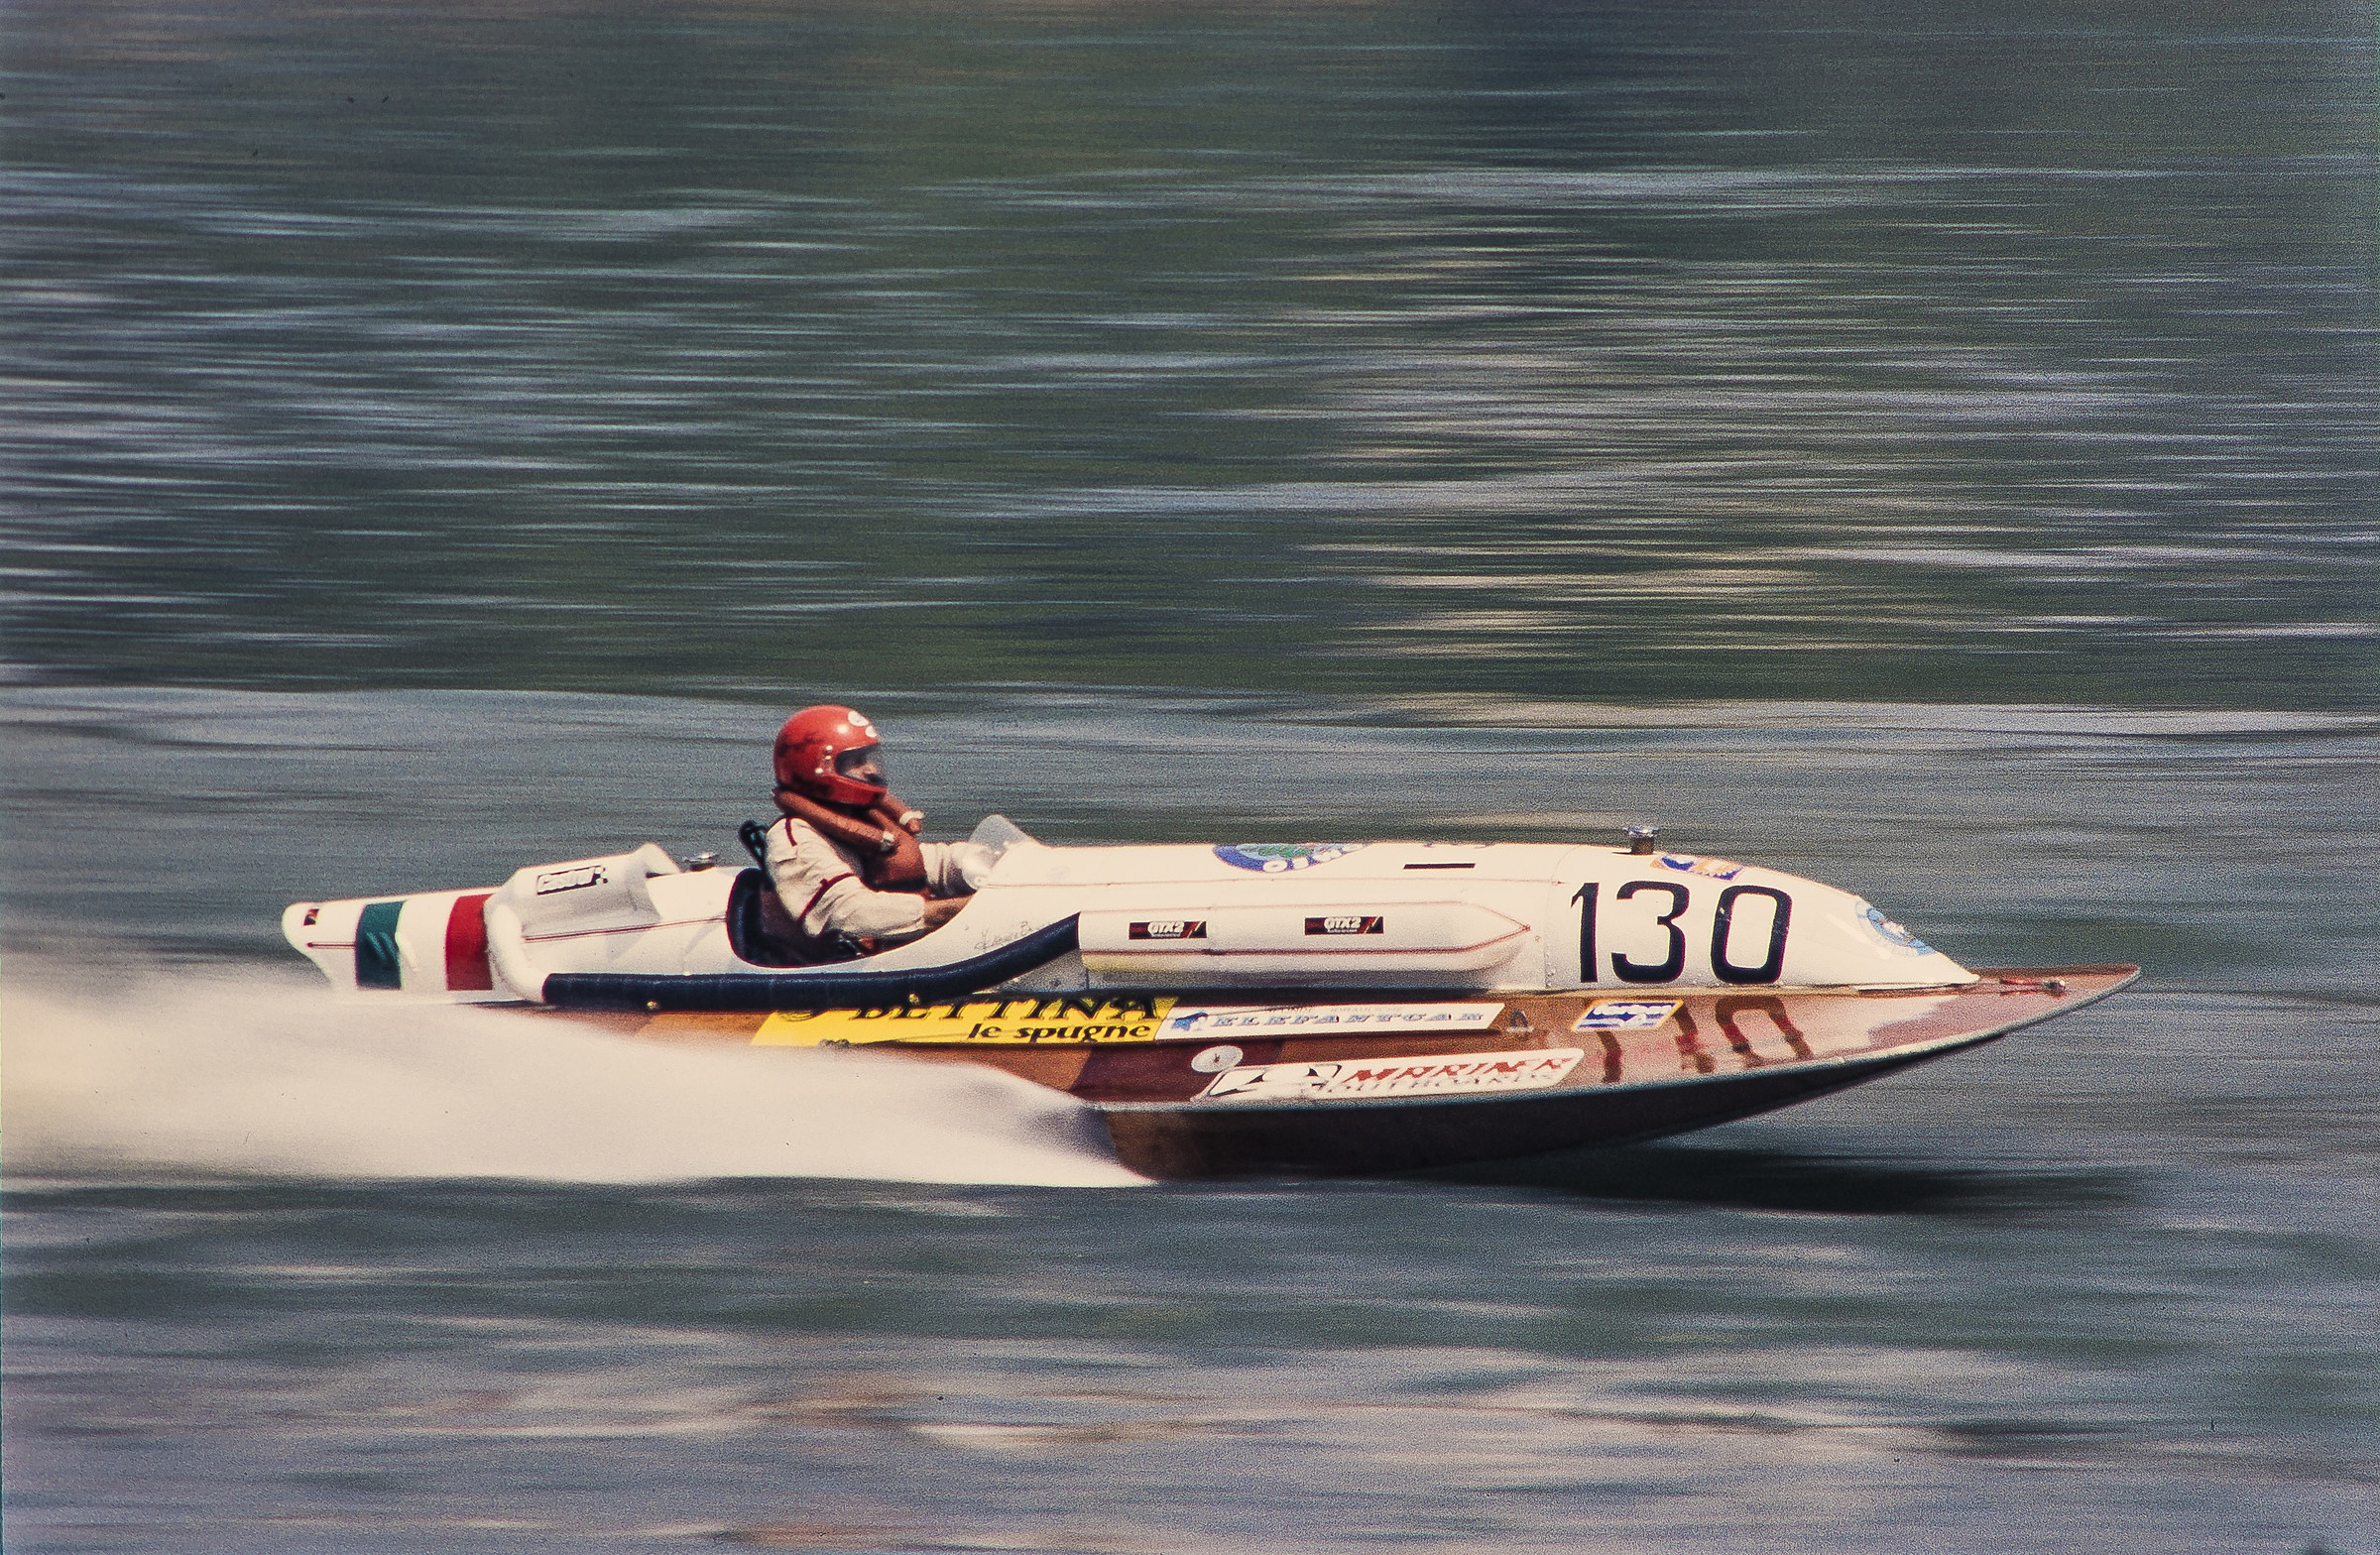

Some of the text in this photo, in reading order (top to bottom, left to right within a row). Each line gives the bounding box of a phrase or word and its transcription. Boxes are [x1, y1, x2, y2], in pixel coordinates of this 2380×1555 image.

[1570, 880, 1793, 985] 130
[968, 1022, 1151, 1042] le spugne
[1340, 1057, 1575, 1084] MARINR
